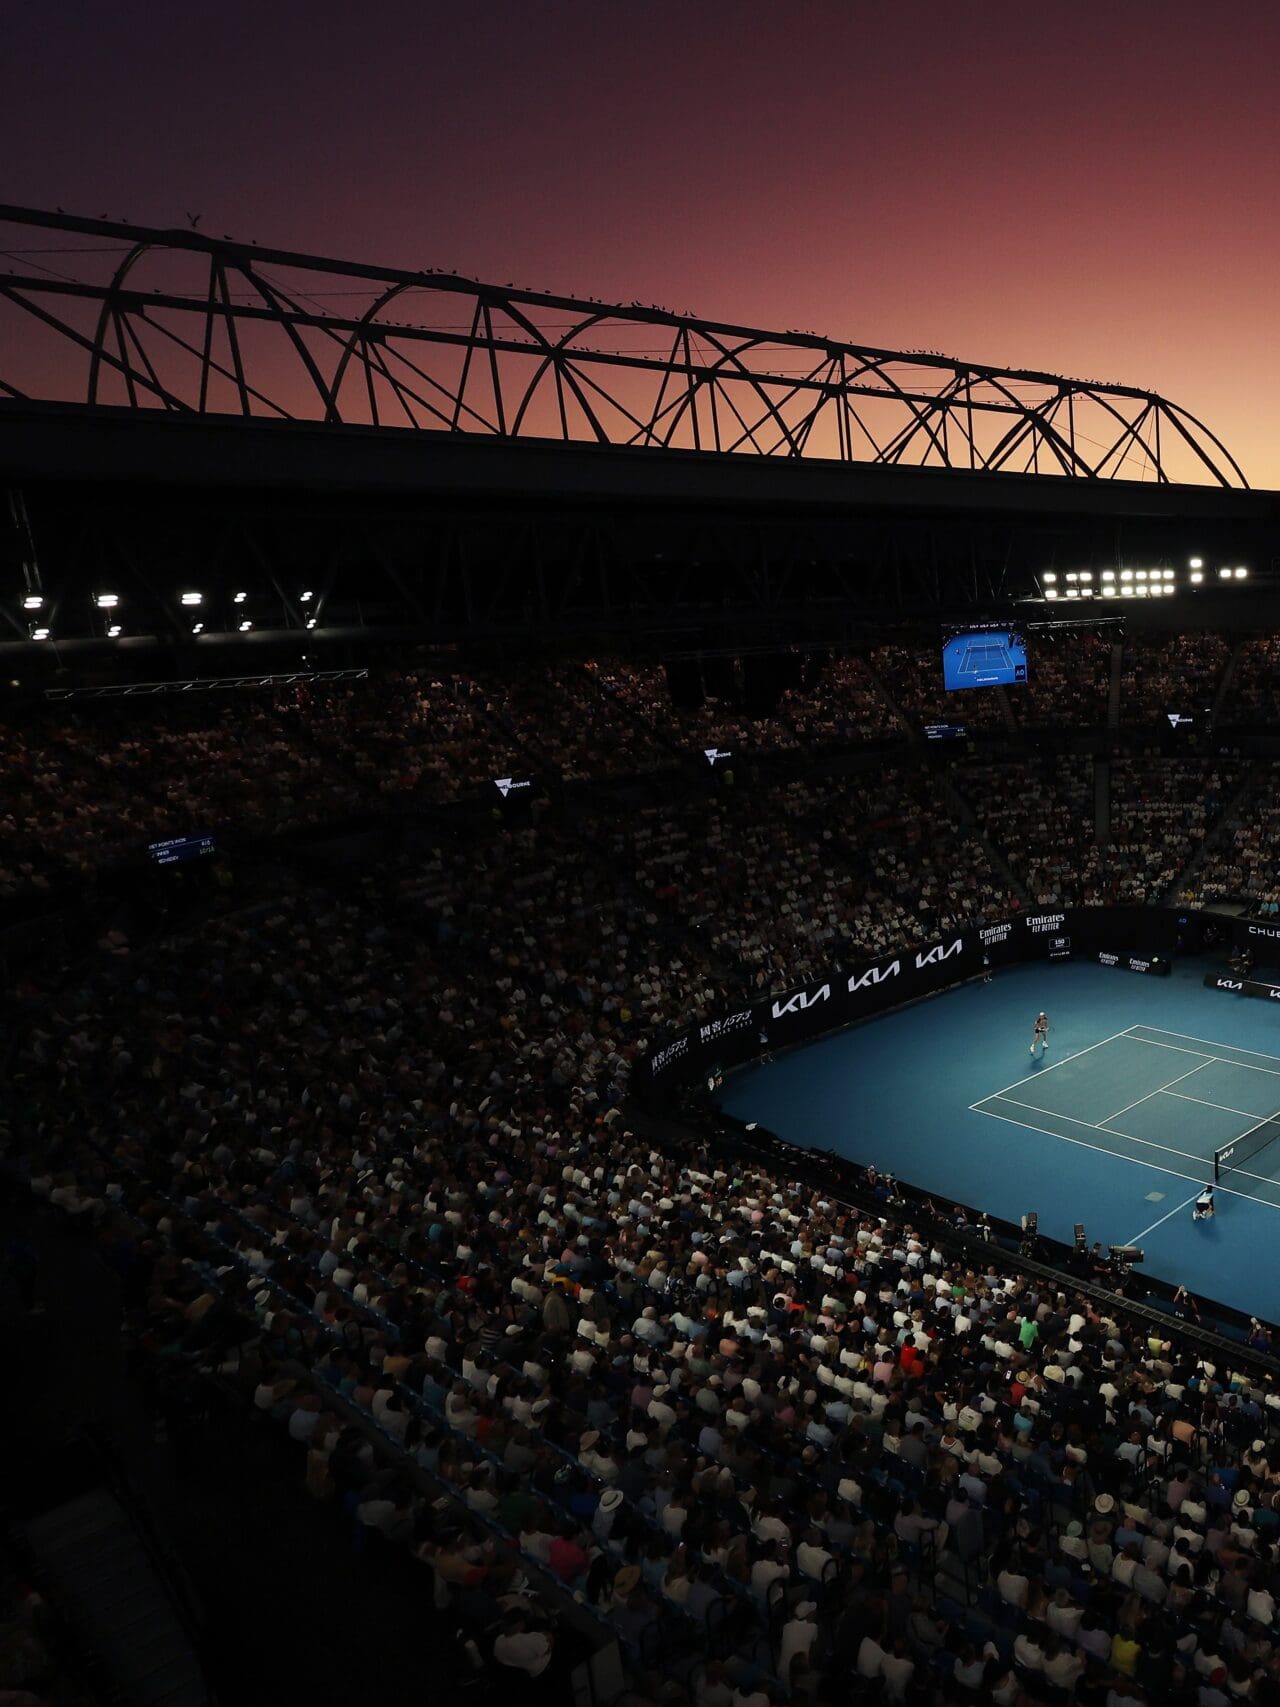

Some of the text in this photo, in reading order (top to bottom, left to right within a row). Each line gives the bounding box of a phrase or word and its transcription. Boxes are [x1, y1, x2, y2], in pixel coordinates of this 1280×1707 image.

[1026, 914, 1065, 926] Emirates
[1032, 922, 1060, 933] FLY BETTER
[979, 923, 1012, 939] Emirates
[915, 938, 963, 969] KIA
[848, 960, 900, 992] KIA
[1217, 978, 1243, 990] KIA
[771, 983, 831, 1019] KIA
